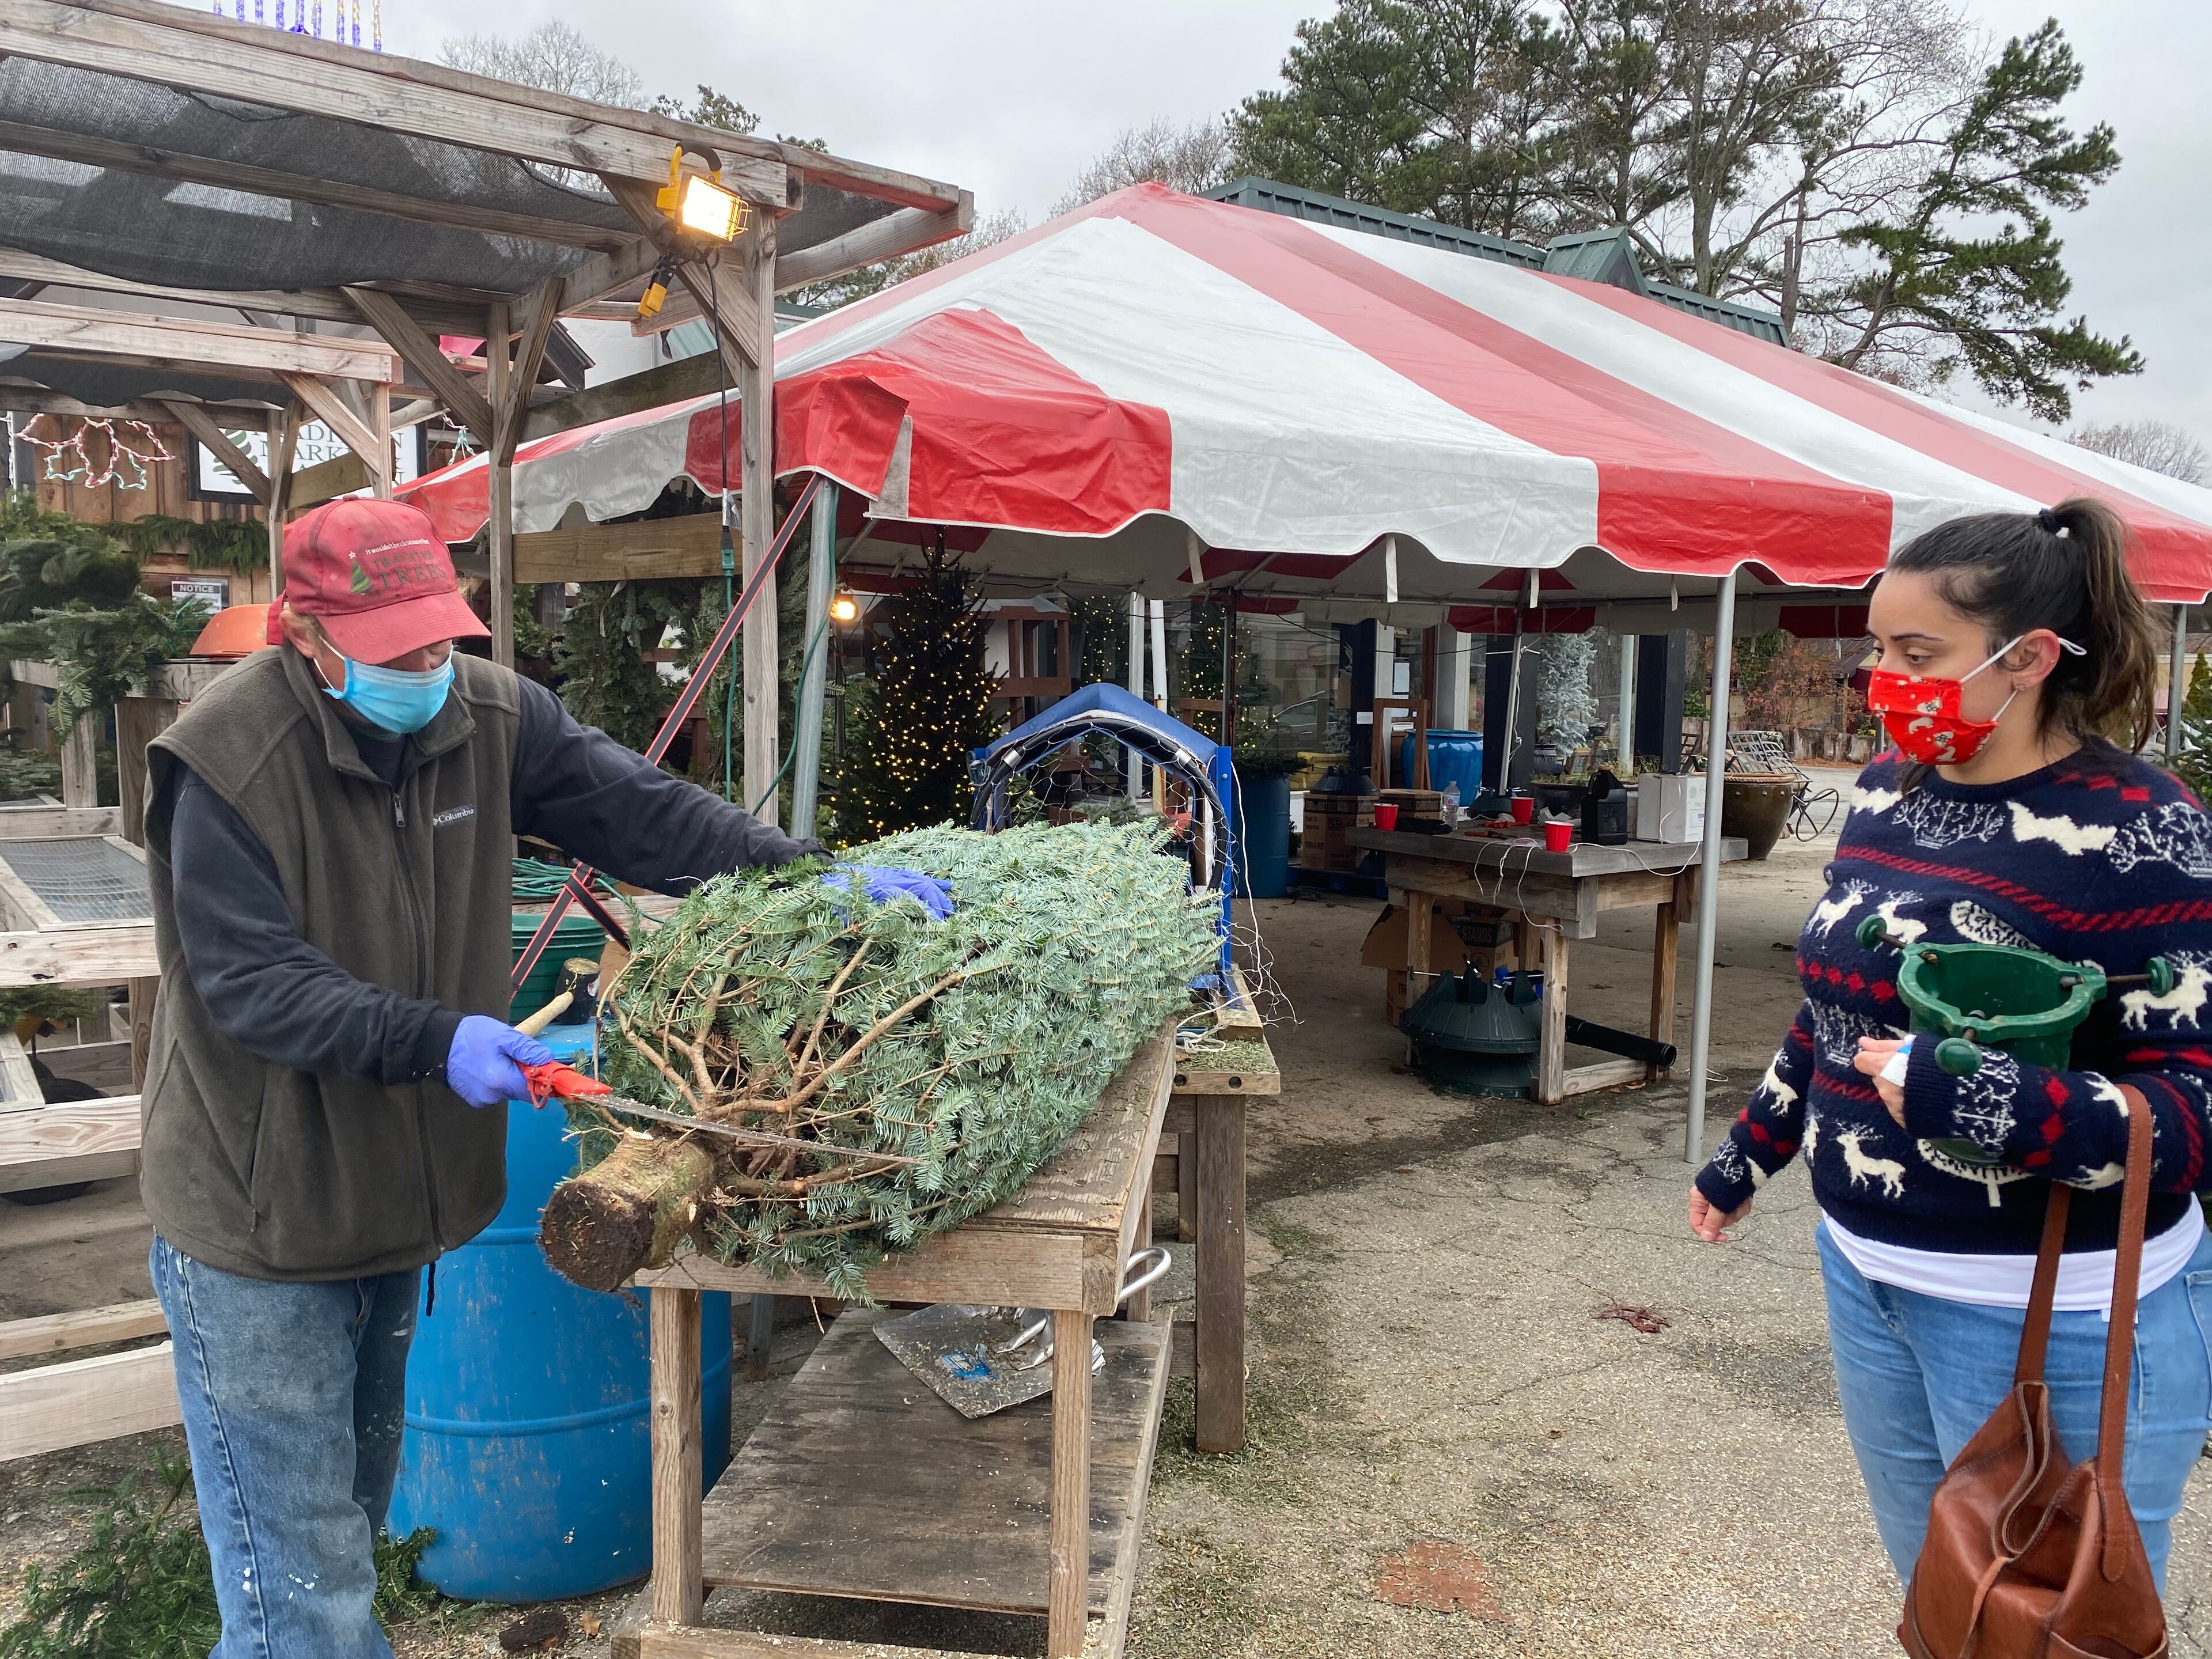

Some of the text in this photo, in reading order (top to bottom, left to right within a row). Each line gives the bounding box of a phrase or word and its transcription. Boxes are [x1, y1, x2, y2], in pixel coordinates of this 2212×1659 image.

[180, 584, 214, 593] NOTICE
[438, 808, 474, 823] Columbia
[1463, 925, 1493, 944] STANDS
